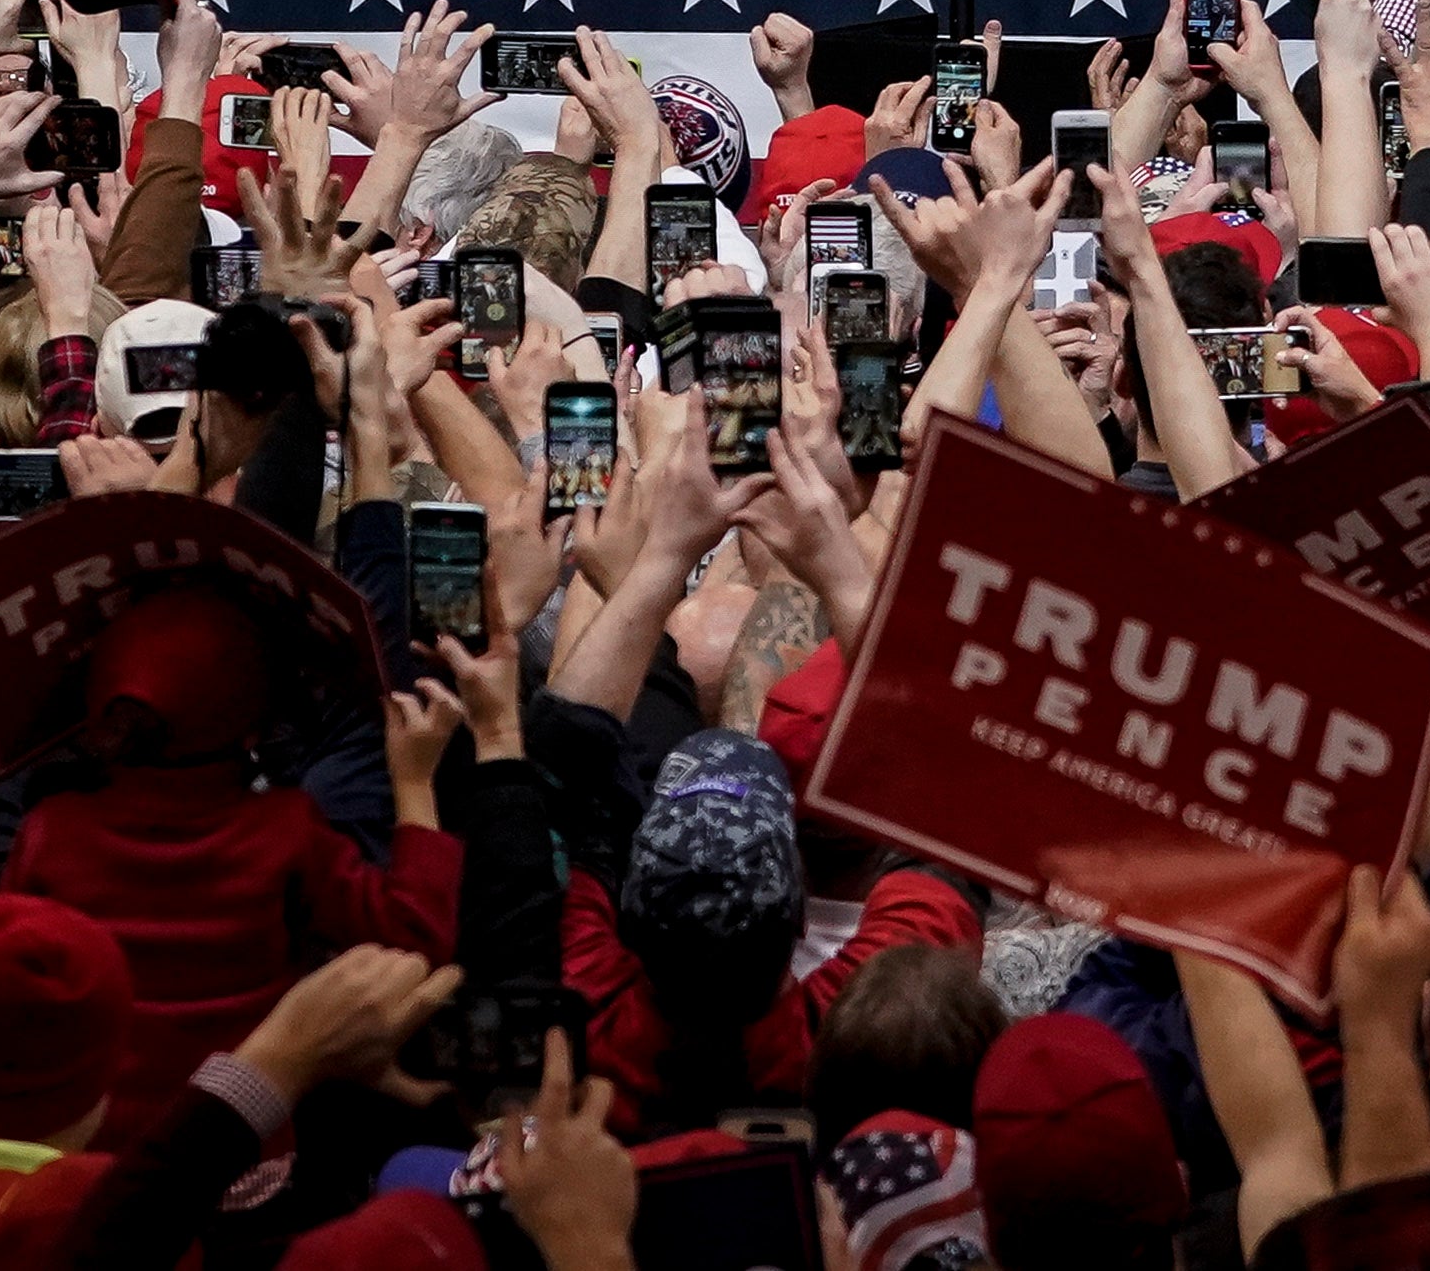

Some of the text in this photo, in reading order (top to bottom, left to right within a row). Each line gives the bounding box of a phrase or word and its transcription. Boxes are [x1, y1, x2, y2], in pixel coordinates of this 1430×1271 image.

[936, 542, 1393, 786] TRUMP
[950, 640, 1335, 838] PENCE
[969, 714, 1175, 818] KEEP AMERICA
